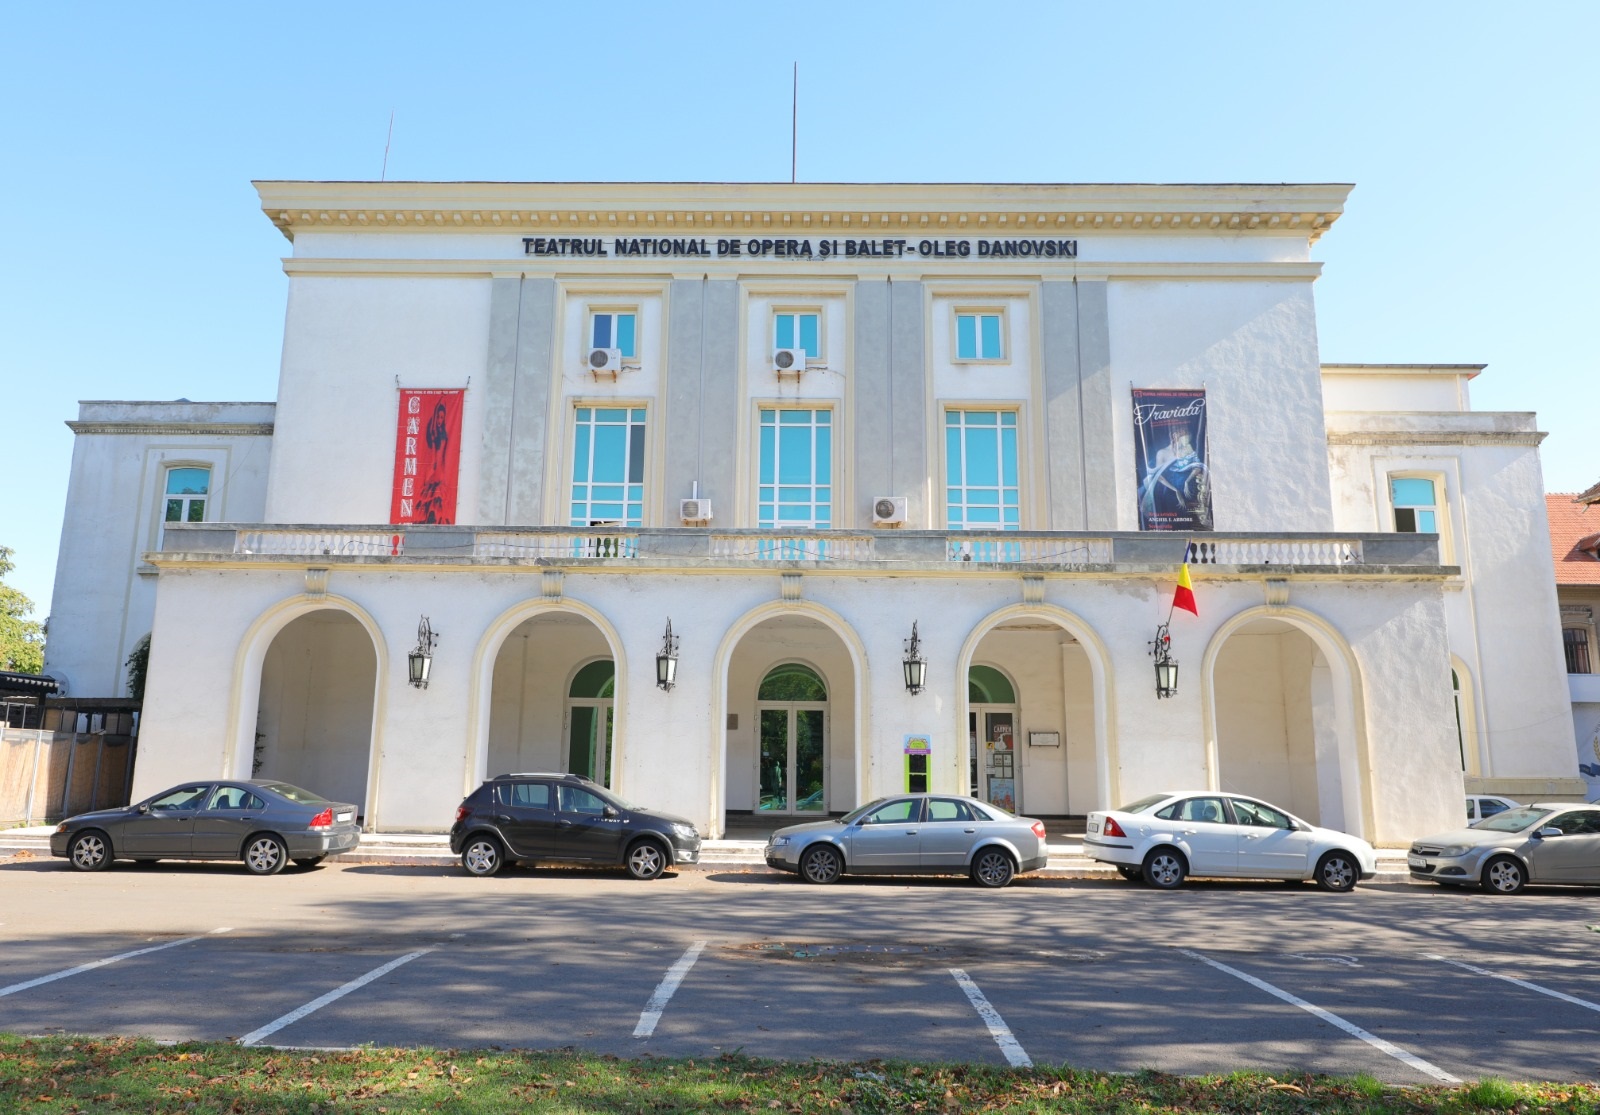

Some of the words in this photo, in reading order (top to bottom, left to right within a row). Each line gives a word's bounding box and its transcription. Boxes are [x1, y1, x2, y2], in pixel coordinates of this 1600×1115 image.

[522, 238, 607, 256] TEATRUL
[614, 239, 711, 257] NATIONAL
[717, 239, 741, 256] DE
[747, 239, 813, 257] OPERA
[819, 239, 838, 257] SI
[978, 240, 1078, 258] DANOVSKI
[401, 396, 420, 517] CARMEN
